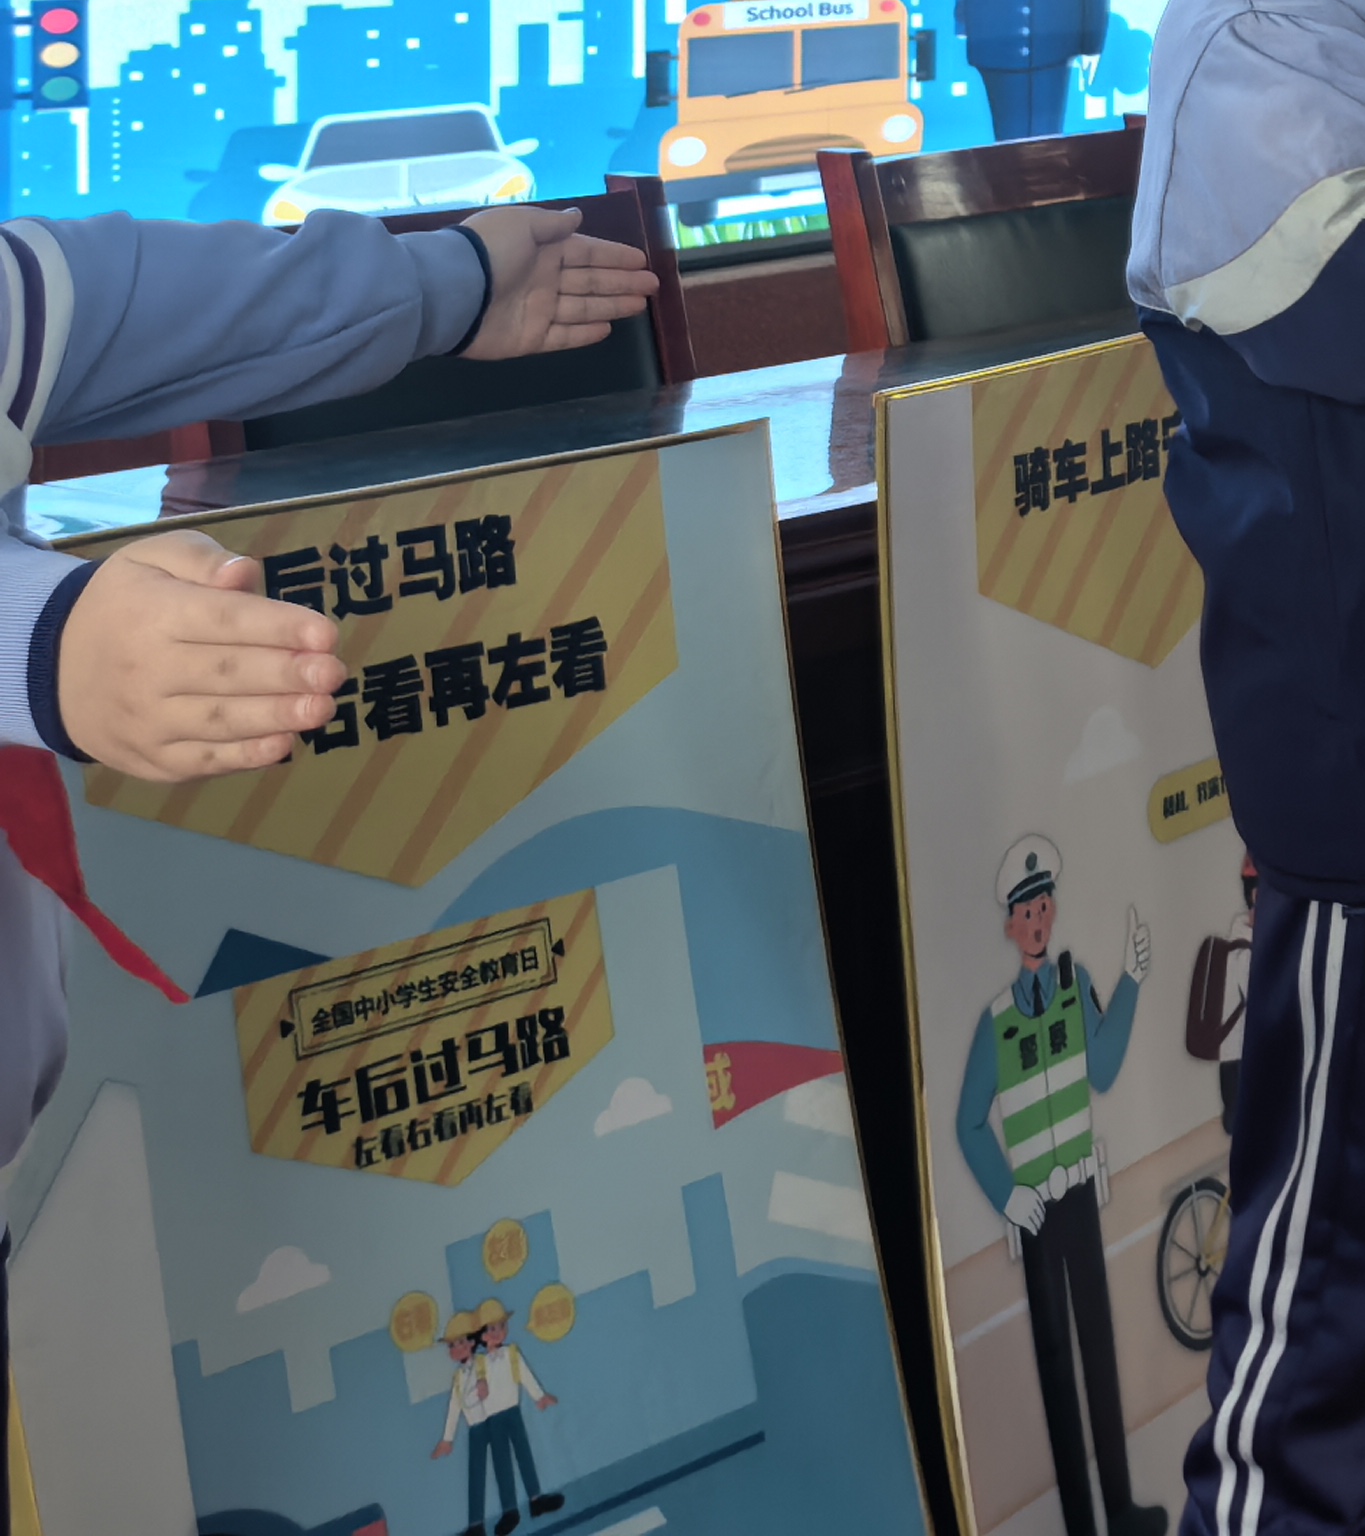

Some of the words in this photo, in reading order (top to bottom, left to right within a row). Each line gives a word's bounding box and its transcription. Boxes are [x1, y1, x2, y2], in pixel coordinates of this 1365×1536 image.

[746, 3, 814, 22] School
[818, 1, 854, 17] Bus
[263, 513, 517, 620] 后过马路
[277, 615, 608, 764] 右看再左看
[311, 945, 540, 1037] 全国中小学生安全教育日
[297, 1005, 571, 1136] 车后过马路
[352, 1081, 534, 1169] 左看右看再左看
